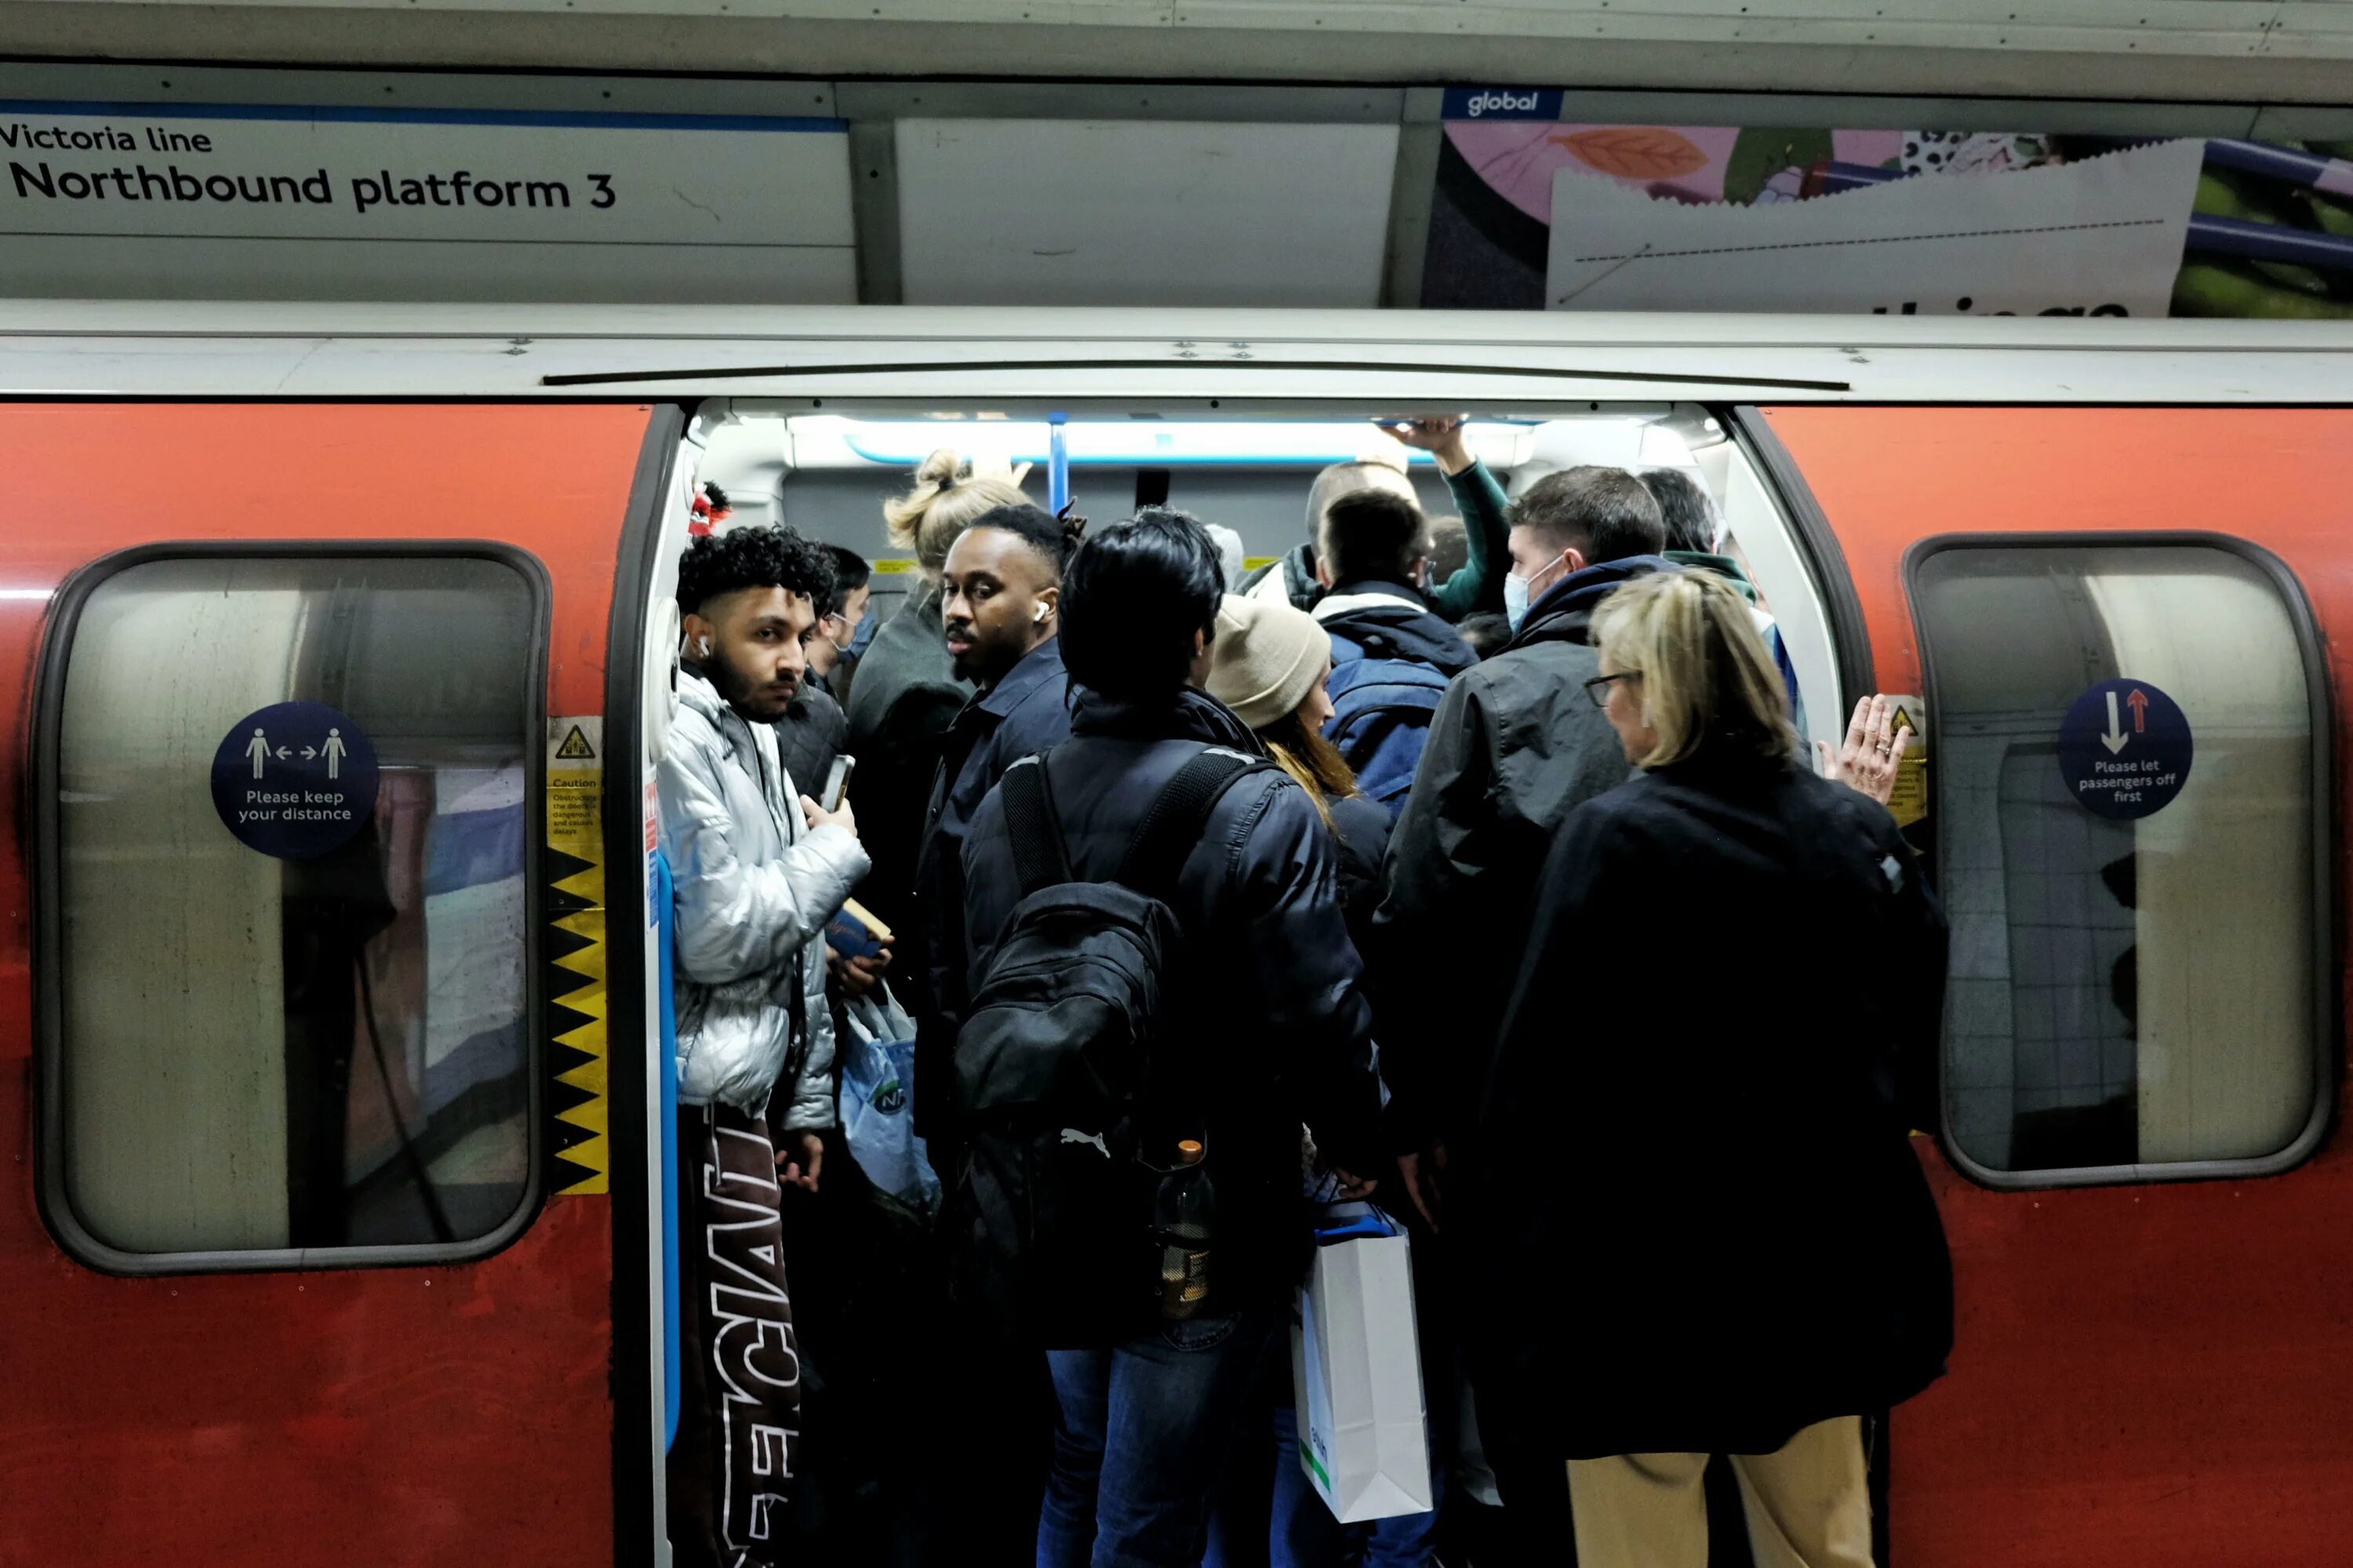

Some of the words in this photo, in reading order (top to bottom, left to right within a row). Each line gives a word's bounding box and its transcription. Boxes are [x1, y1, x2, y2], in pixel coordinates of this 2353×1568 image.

[1468, 91, 1538, 117] global
[0, 122, 136, 151] Victoria
[145, 126, 213, 152] line
[9, 161, 333, 205] Northbound
[351, 169, 570, 213] platform
[587, 173, 616, 209] 3
[2095, 761, 2137, 773] Please
[2141, 760, 2159, 772] let
[553, 778, 597, 788] Caution
[2079, 775, 2152, 791] passengers
[2155, 773, 2177, 785] off
[246, 790, 300, 804] Please
[304, 790, 344, 806] keep
[2114, 791, 2142, 802] first
[238, 809, 277, 824] your
[282, 807, 351, 820] distance
